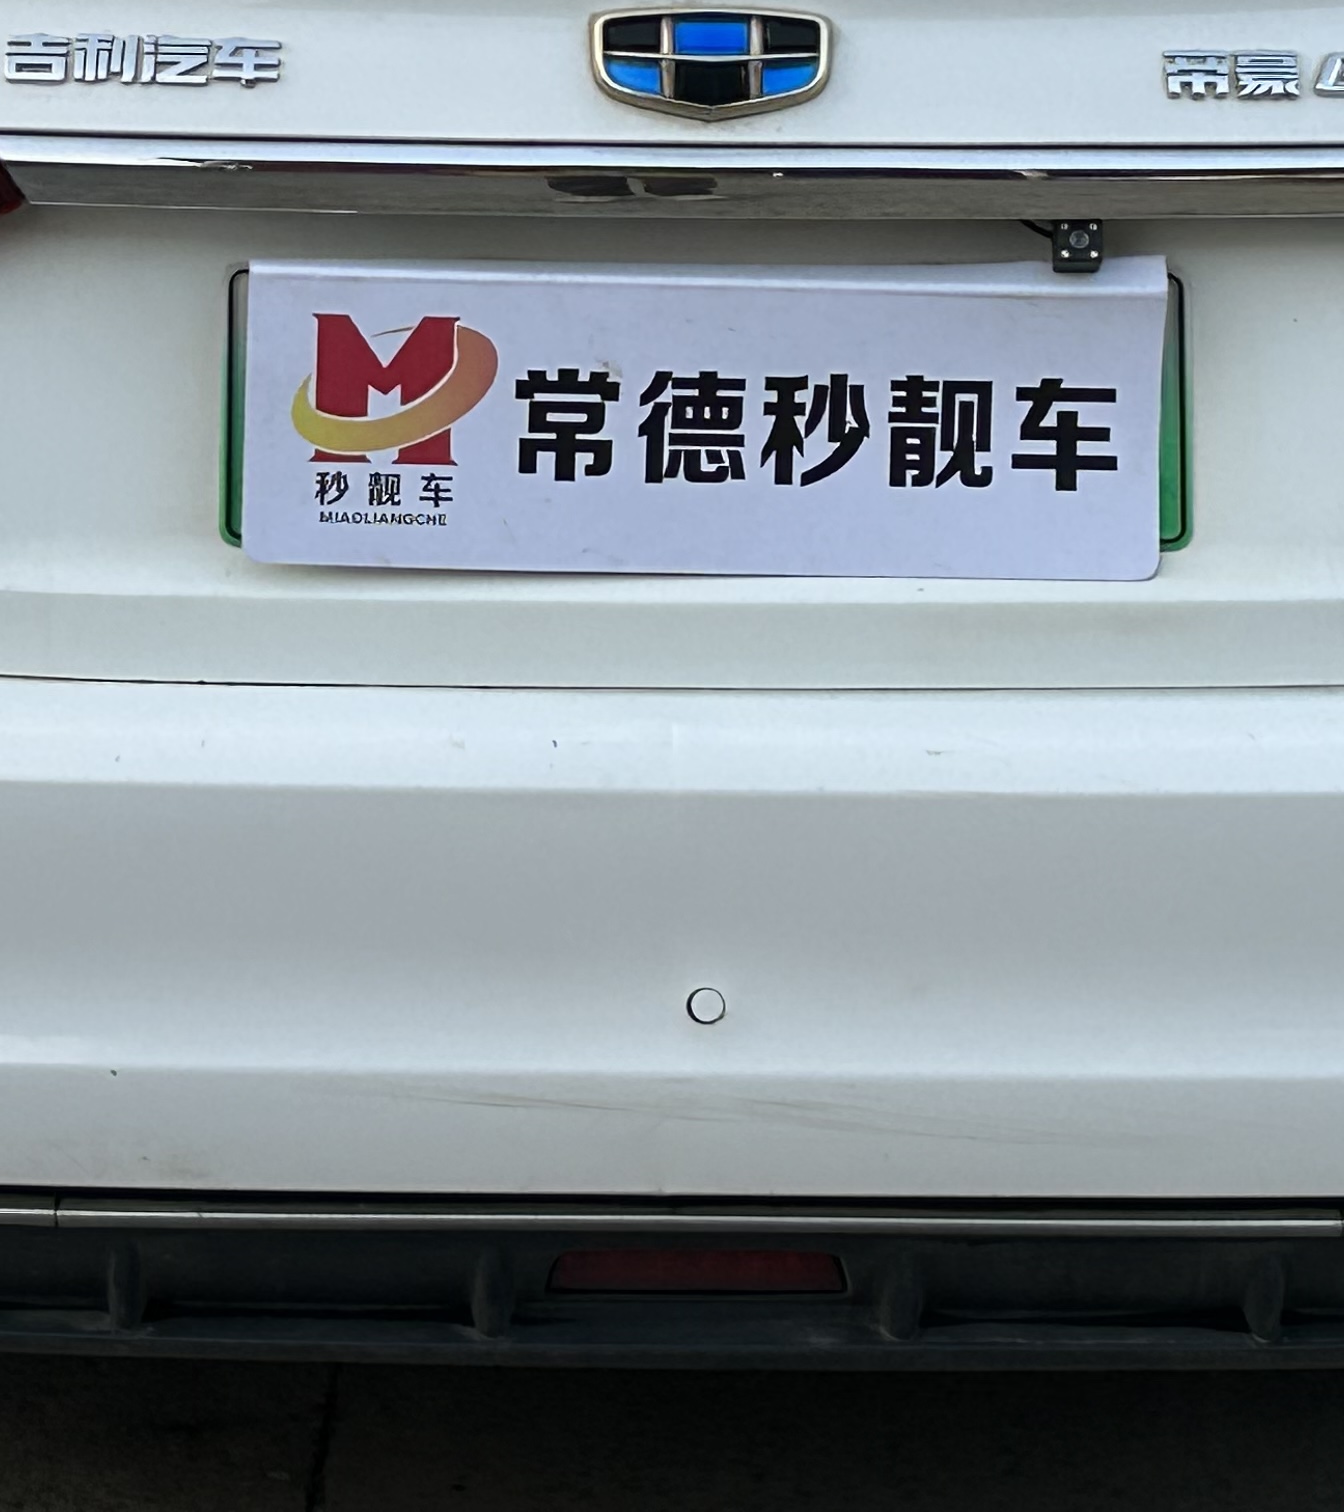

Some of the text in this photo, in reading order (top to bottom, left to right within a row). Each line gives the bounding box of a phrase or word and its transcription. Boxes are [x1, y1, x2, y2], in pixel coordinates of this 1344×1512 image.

[4, 33, 283, 89] 吉利汽车
[1162, 50, 1300, 100] 帝豪
[309, 313, 461, 466] M
[515, 368, 1119, 491] 常德秒靓车
[314, 471, 454, 507] 秒靓车
